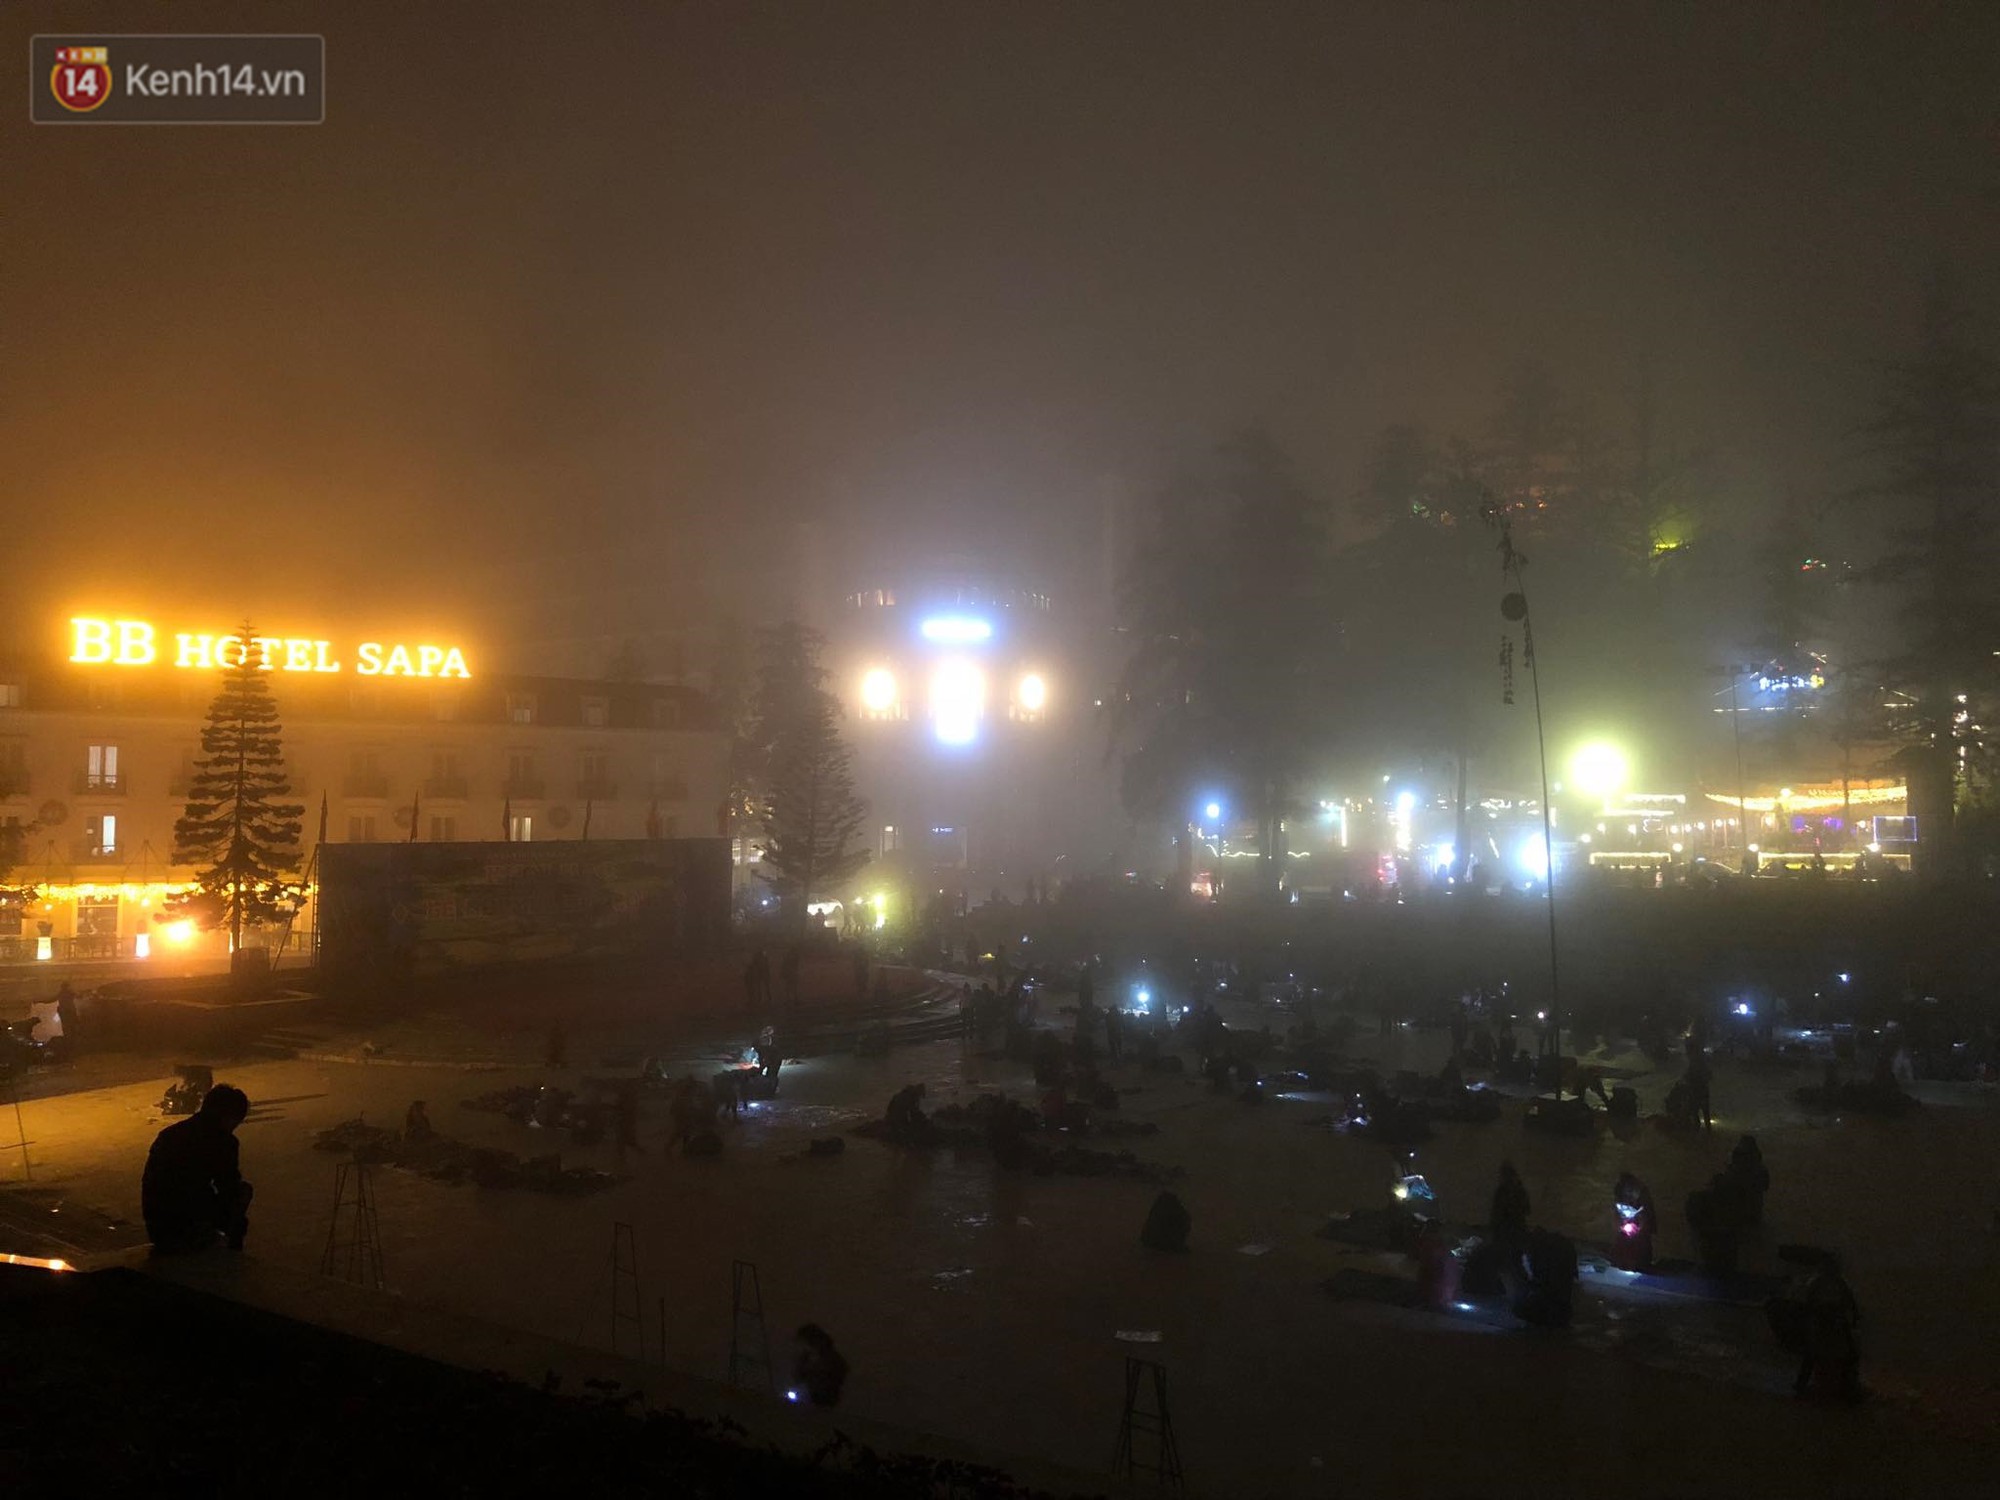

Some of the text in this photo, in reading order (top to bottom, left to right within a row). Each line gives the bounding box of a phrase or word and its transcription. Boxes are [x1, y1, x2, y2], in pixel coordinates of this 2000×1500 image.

[69, 616, 472, 679] BB HOTEL SAPA
